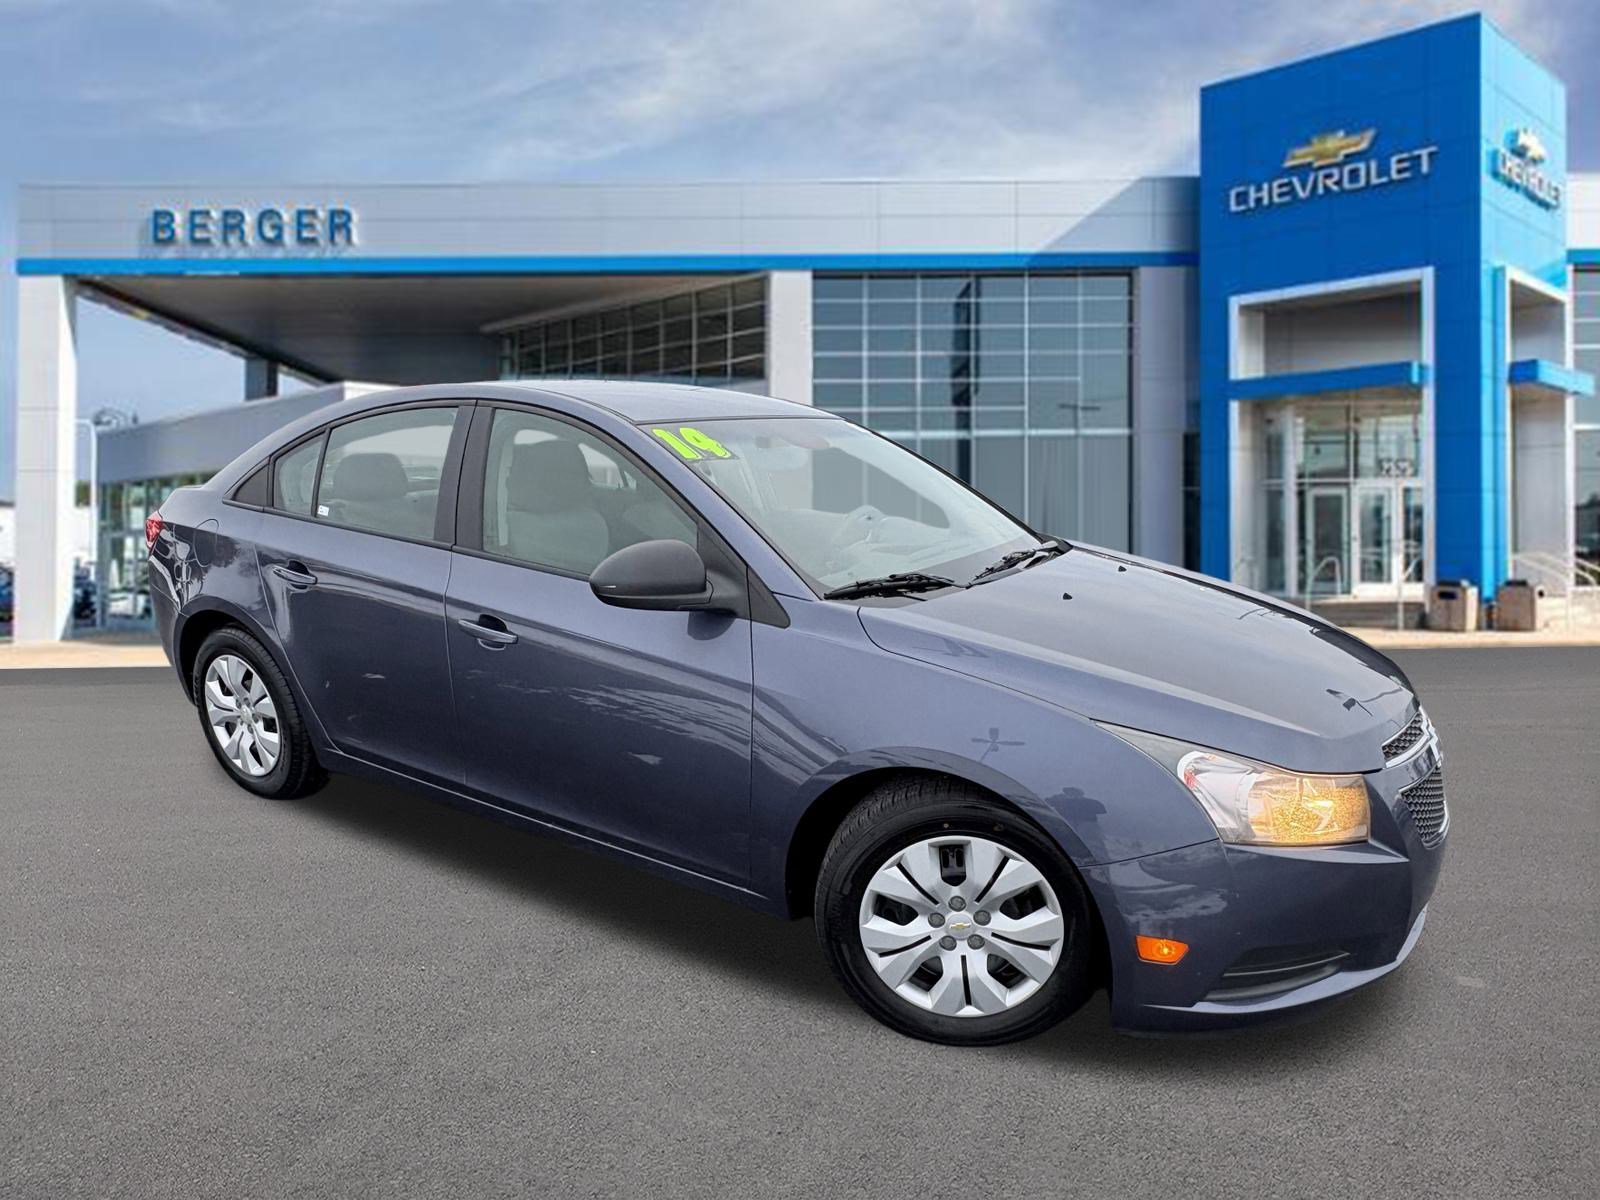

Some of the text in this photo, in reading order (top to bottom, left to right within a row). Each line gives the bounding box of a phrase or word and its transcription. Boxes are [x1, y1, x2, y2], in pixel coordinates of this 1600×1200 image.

[1228, 145, 1438, 213] CHEVROLET
[152, 207, 356, 246] BERGER
[652, 426, 732, 460] 14
